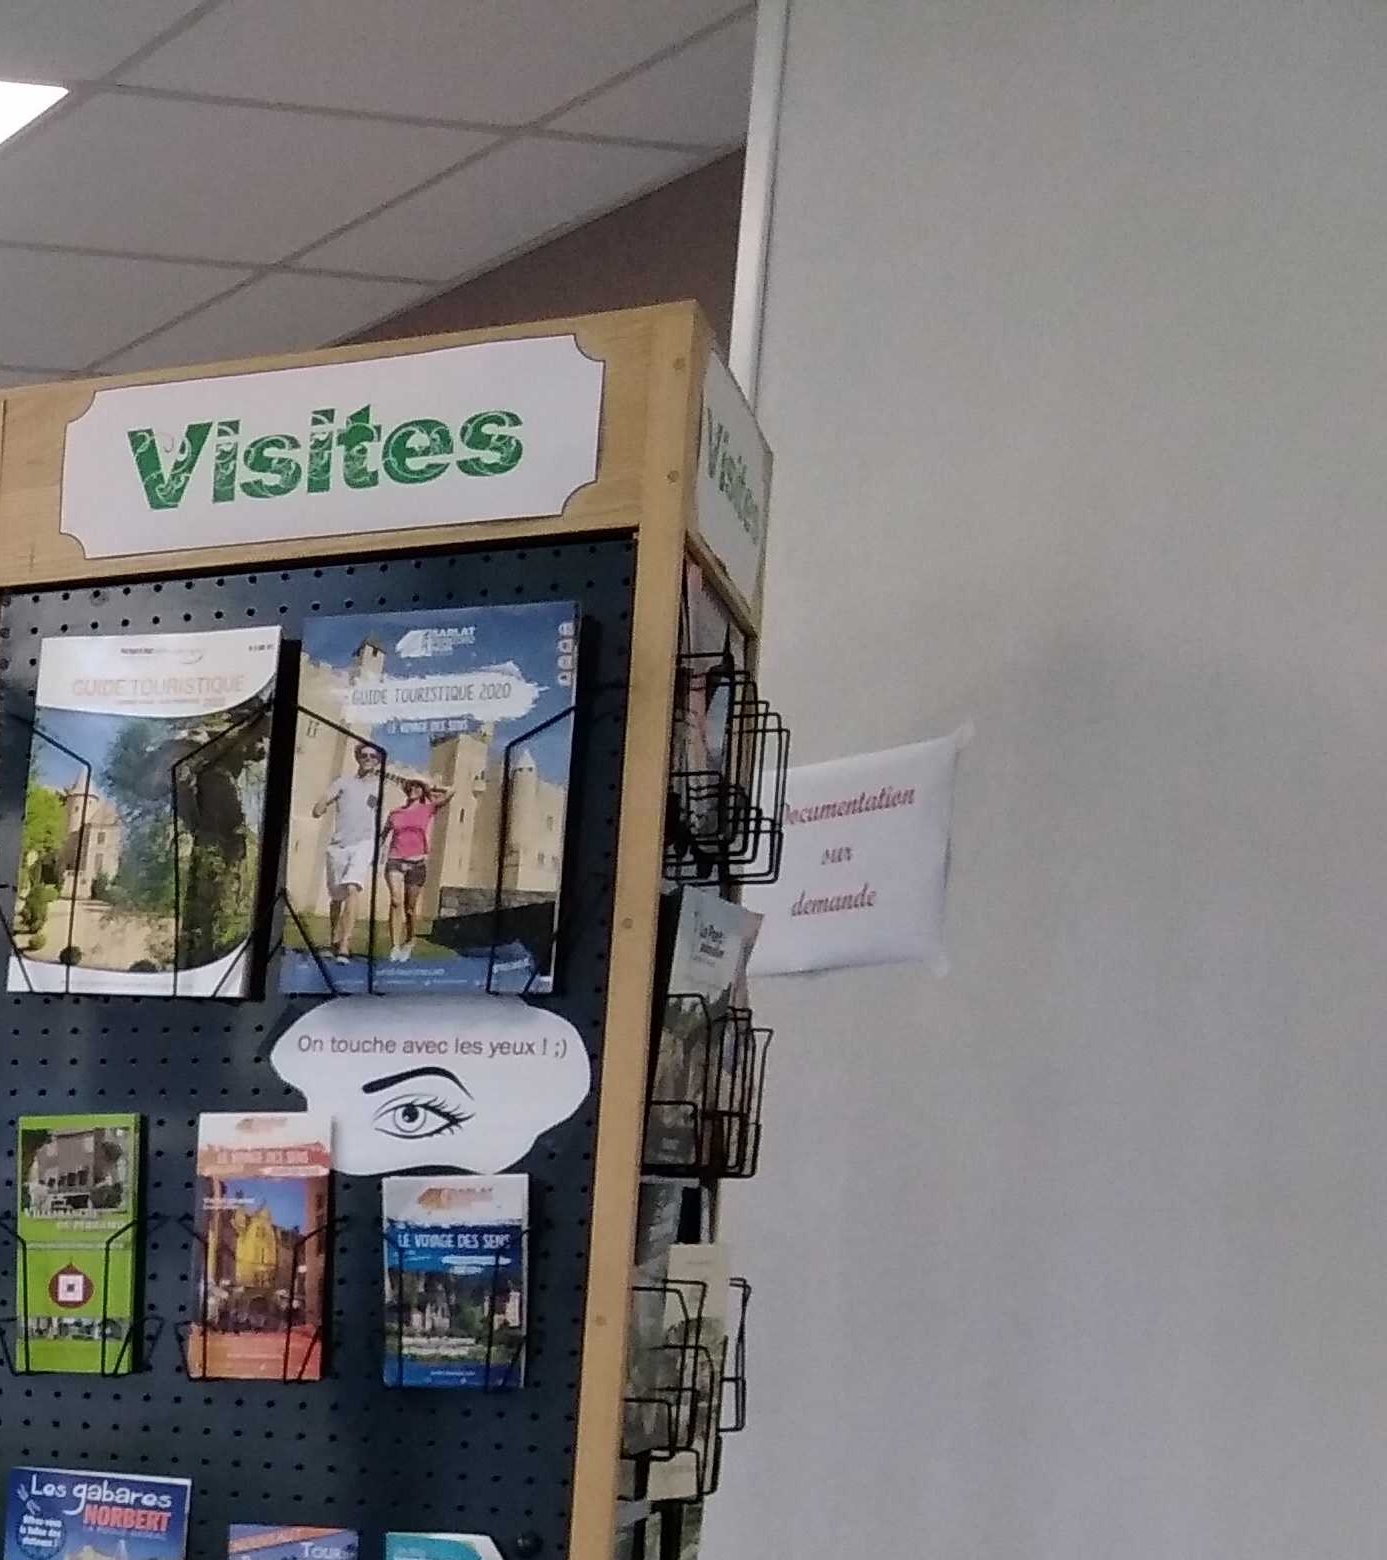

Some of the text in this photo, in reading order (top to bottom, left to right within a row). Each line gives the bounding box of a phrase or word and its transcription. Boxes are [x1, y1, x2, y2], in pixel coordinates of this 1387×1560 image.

[126, 403, 525, 511] Visites
[707, 407, 760, 546] Visites
[73, 674, 246, 697] GUIDE TOURISTIQUE
[351, 682, 512, 705] GUIDE TOURISTIQUE 2020
[791, 882, 876, 916] demande
[298, 1035, 324, 1053] On
[330, 1037, 396, 1054] touche
[402, 1040, 449, 1054] avec
[455, 1038, 484, 1055] les
[488, 1040, 536, 1059] yeux
[542, 1038, 547, 1050] !
[397, 1234, 411, 1248] LE
[414, 1234, 454, 1248] VOYAGE
[457, 1234, 479, 1248] DES
[31, 1474, 172, 1516] Les gabares
[83, 1503, 172, 1532] NORBERT
